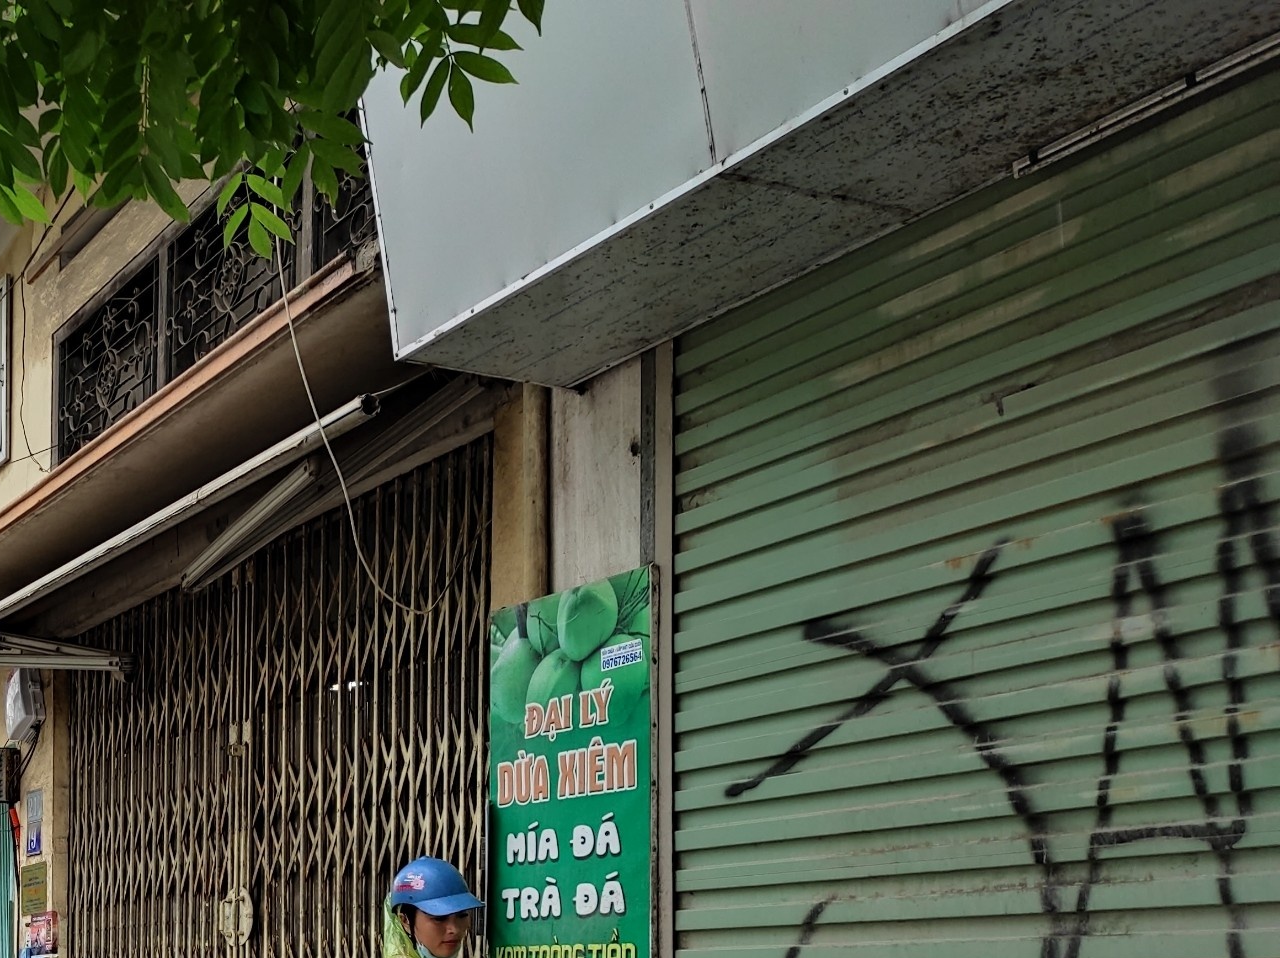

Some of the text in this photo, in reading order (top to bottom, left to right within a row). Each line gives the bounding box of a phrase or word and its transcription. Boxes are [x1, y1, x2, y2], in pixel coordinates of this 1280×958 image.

[602, 650, 642, 670] 0976726564
[525, 677, 614, 741] ĐẠI LÝ
[498, 736, 637, 808] DỪA XIÊM
[506, 812, 621, 864] MÍA ĐÁ
[501, 871, 625, 919] TRÀ ĐÁ
